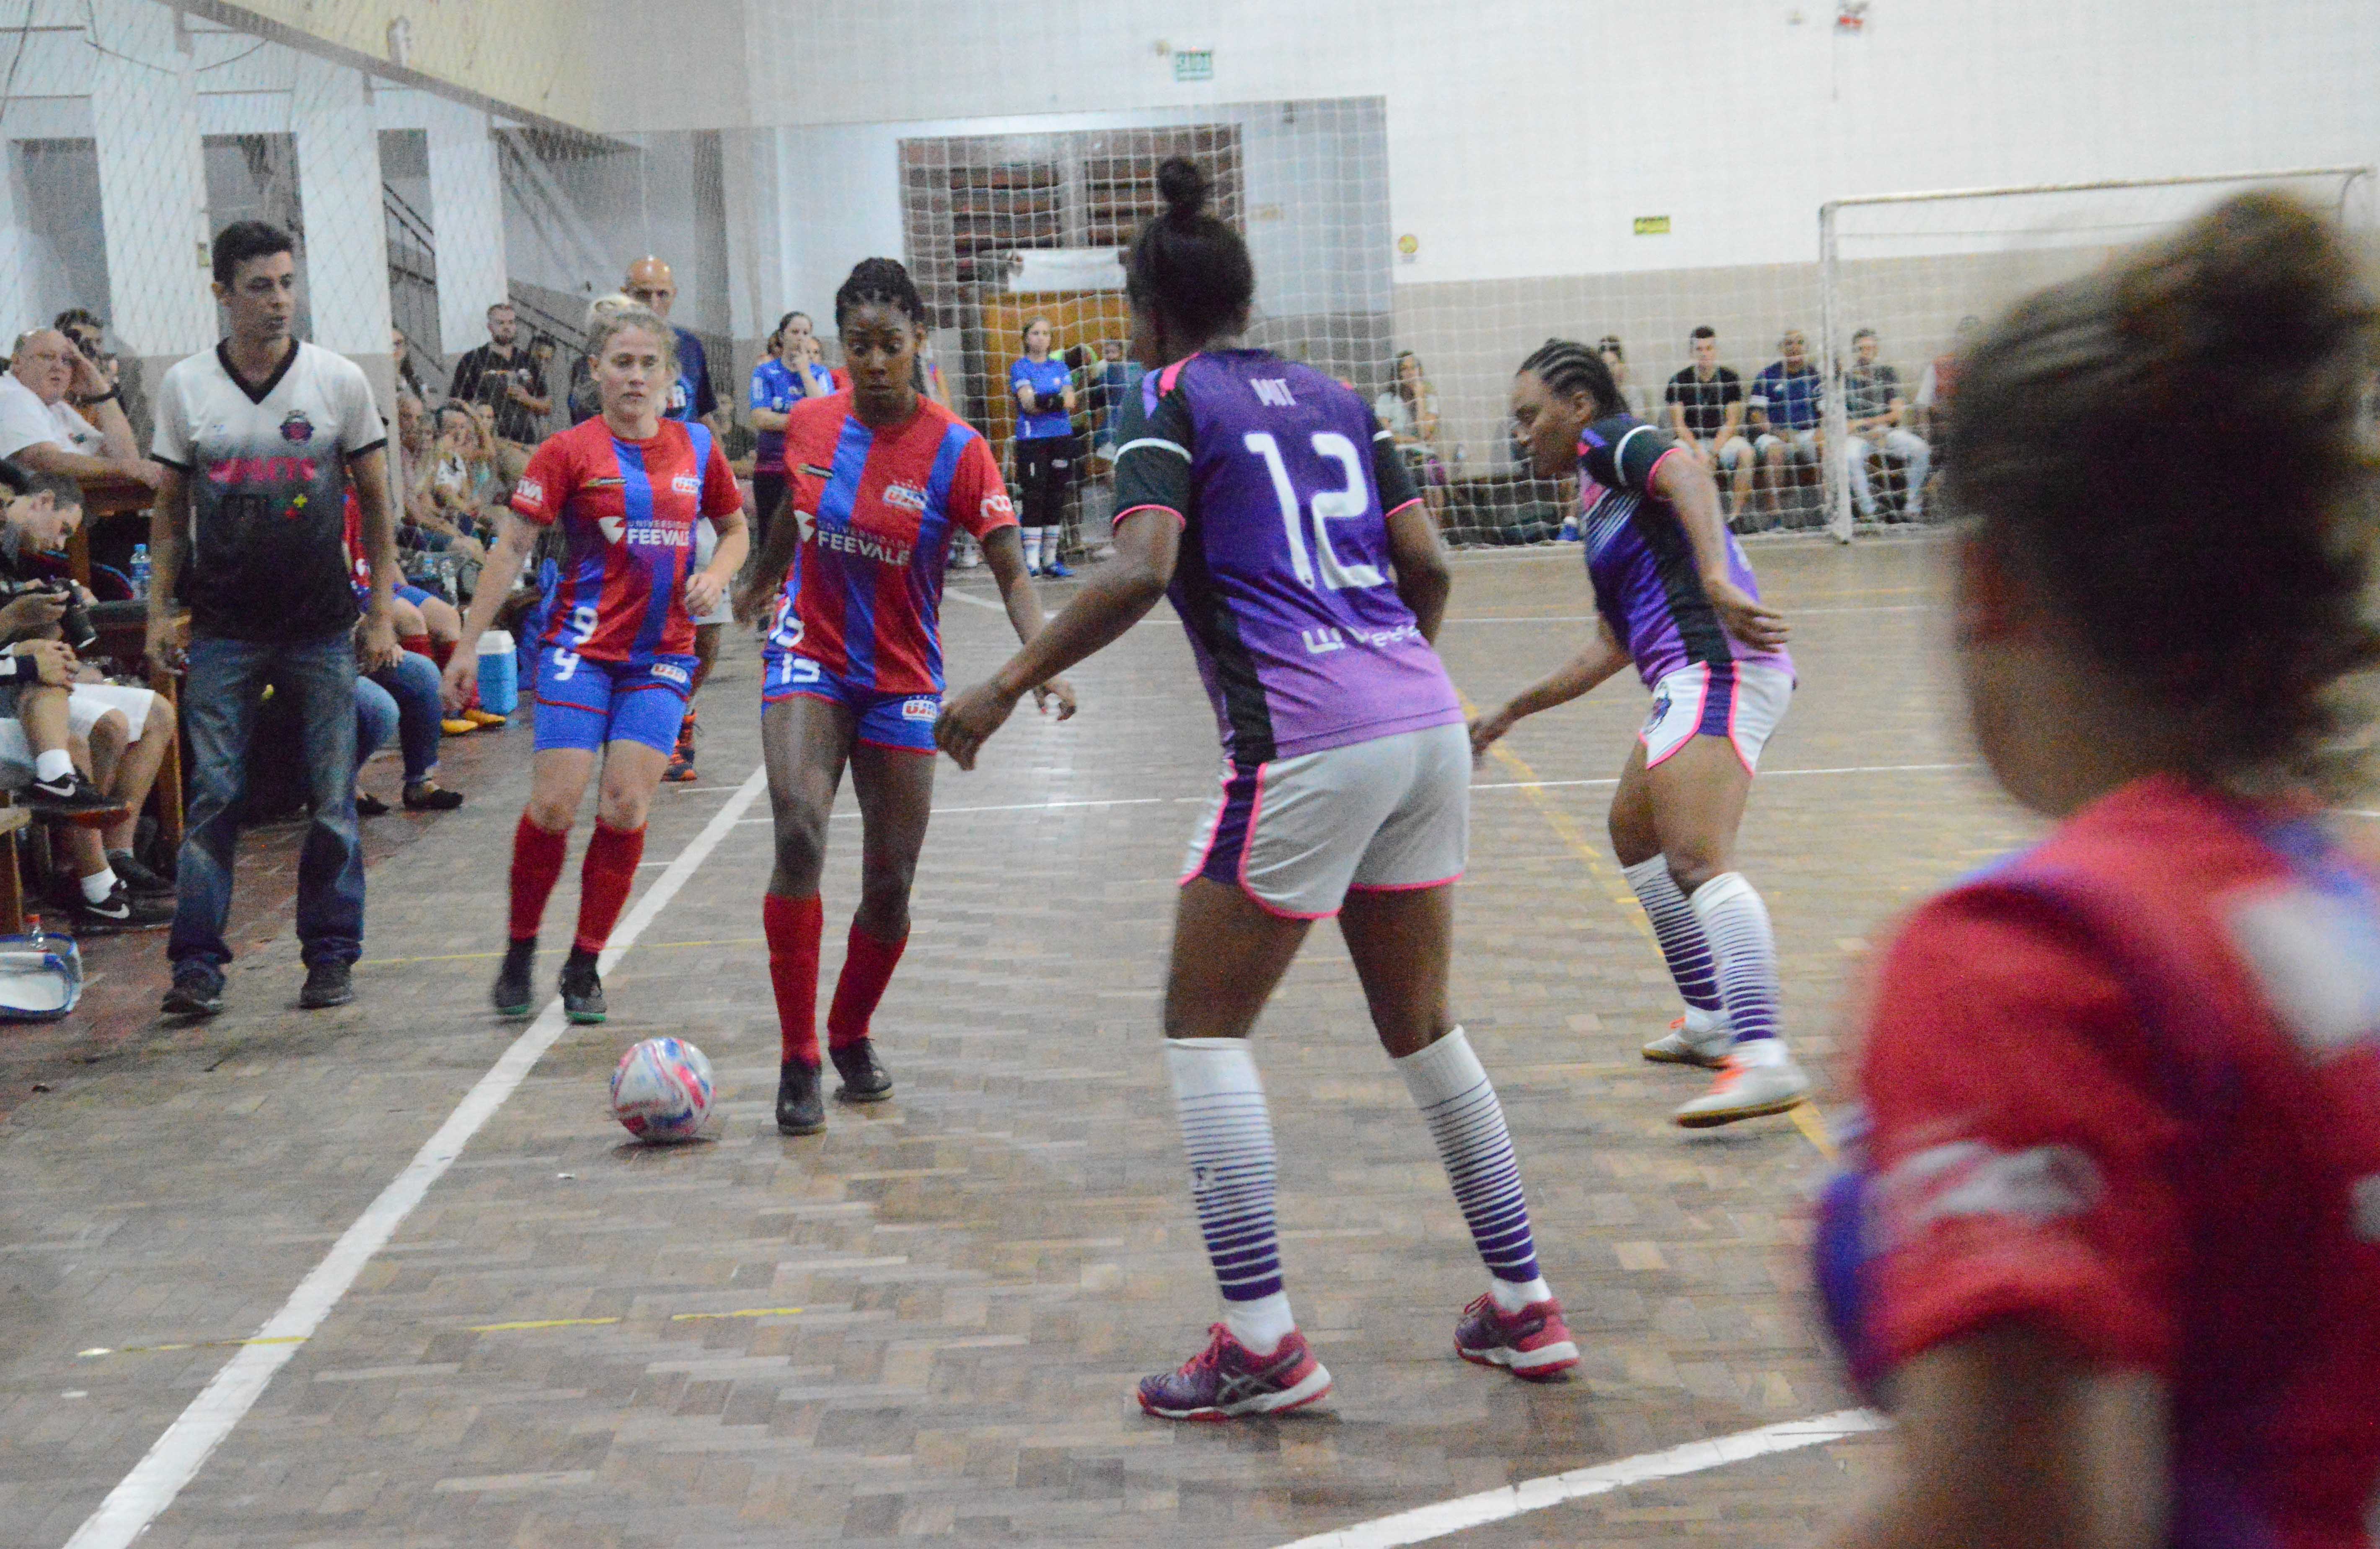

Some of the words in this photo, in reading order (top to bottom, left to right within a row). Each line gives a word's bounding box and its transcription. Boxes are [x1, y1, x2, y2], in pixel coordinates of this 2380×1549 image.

[1243, 432, 1387, 590] 12
[818, 530, 911, 565] FEEVALE
[573, 606, 598, 643] 9
[782, 653, 820, 684] 15
